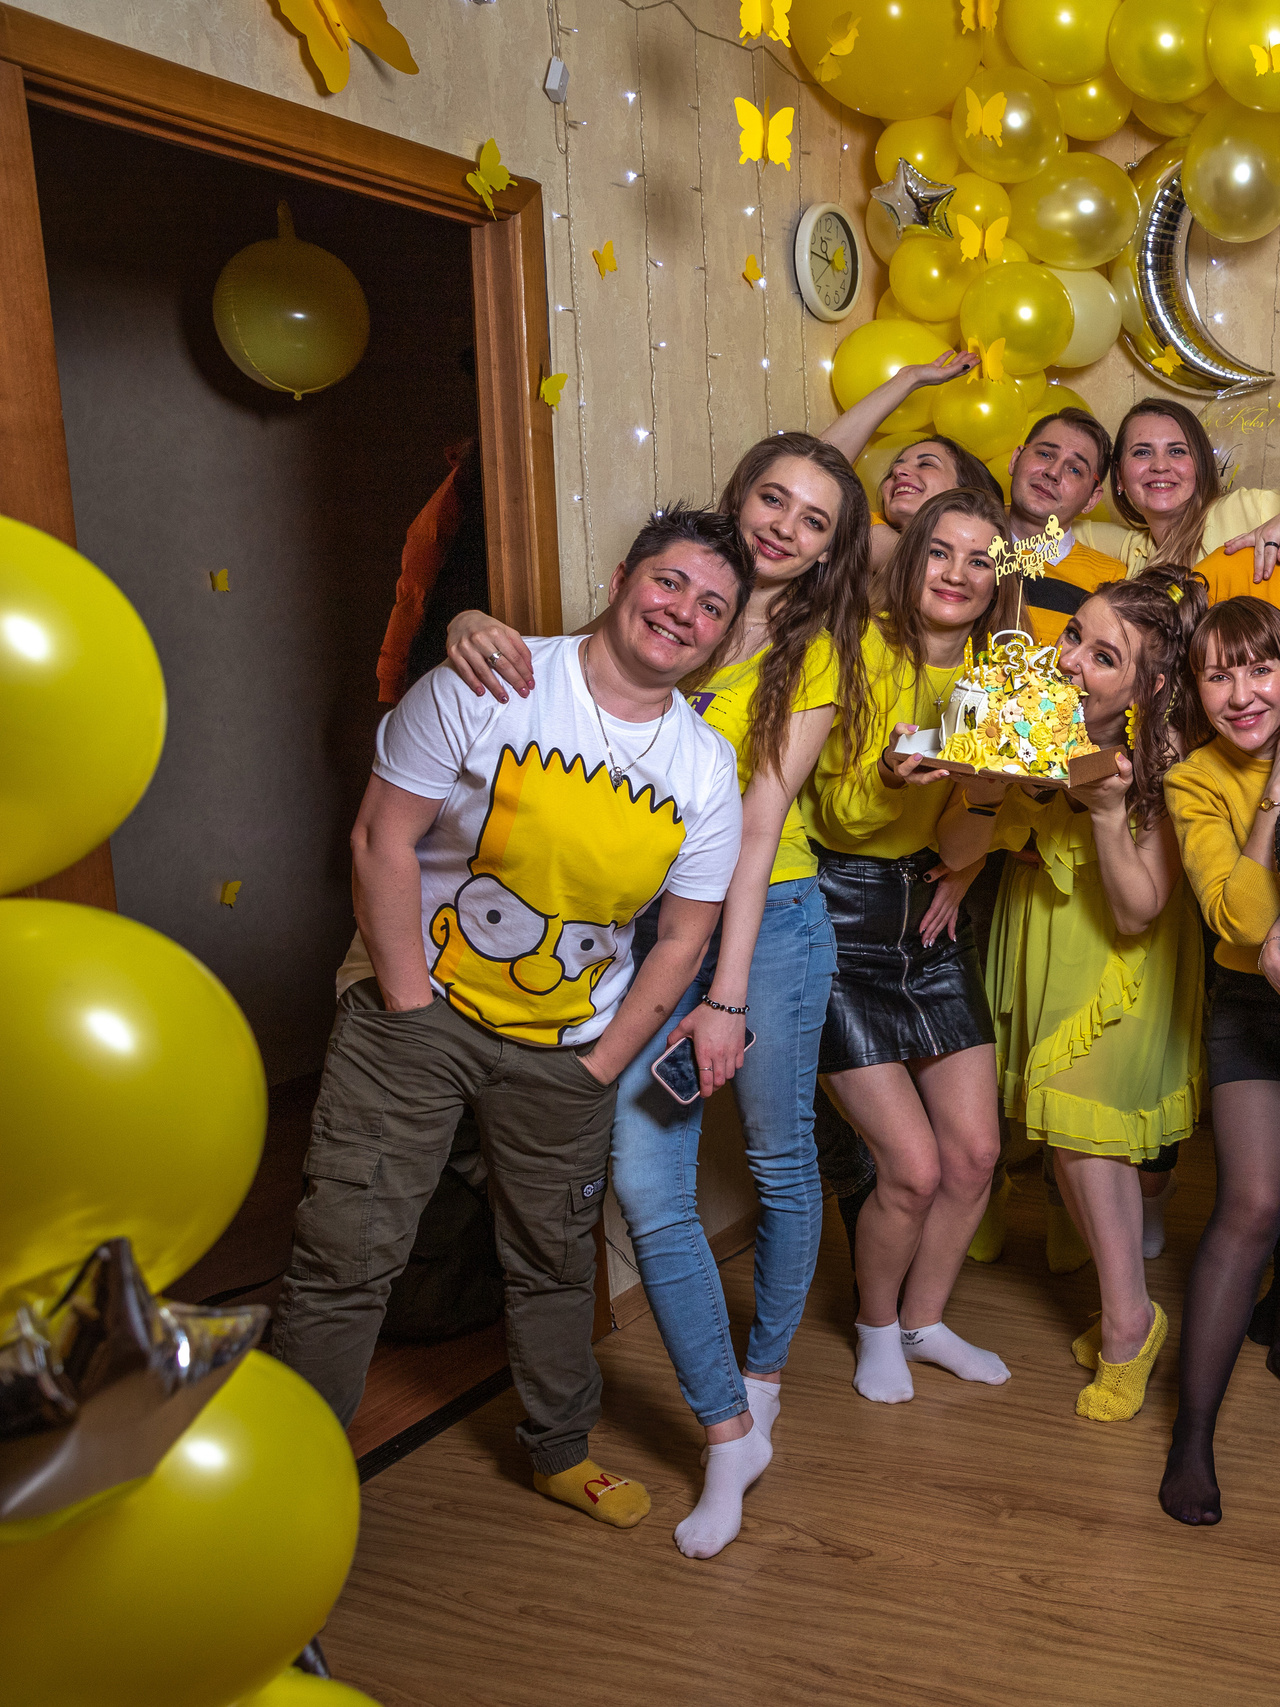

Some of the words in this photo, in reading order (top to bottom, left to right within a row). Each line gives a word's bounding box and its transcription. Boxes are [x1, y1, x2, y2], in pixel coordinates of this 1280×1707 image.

[825, 217, 833, 233] 12
[840, 279, 846, 293] 4
[825, 291, 831, 306] 6
[834, 290, 840, 305] 5
[995, 543, 1061, 586] рождения
[1004, 641, 1058, 680] 34
